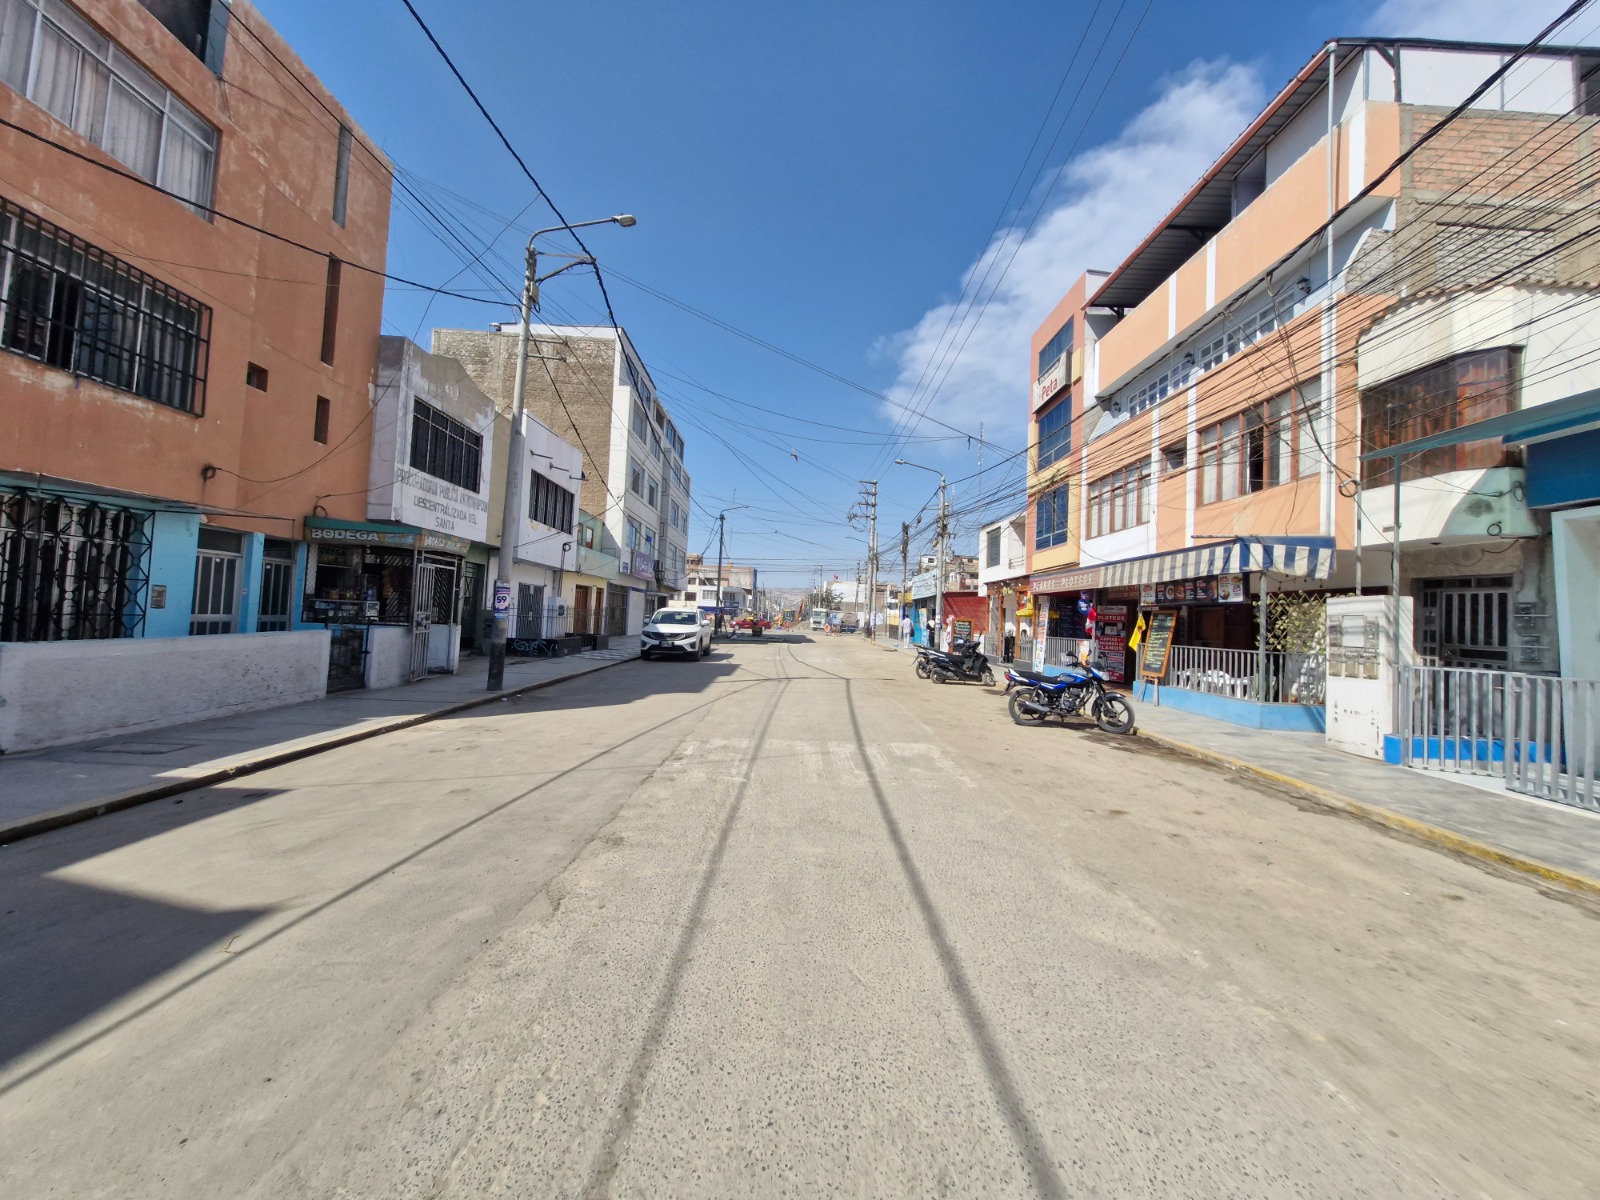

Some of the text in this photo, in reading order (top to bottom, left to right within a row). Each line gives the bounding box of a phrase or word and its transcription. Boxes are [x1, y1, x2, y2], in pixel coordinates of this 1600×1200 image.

[435, 517, 455, 531] SANTA
[311, 528, 379, 541] BODEGA
[424, 536, 445, 547] BODEGA
[496, 595, 508, 604] 59
